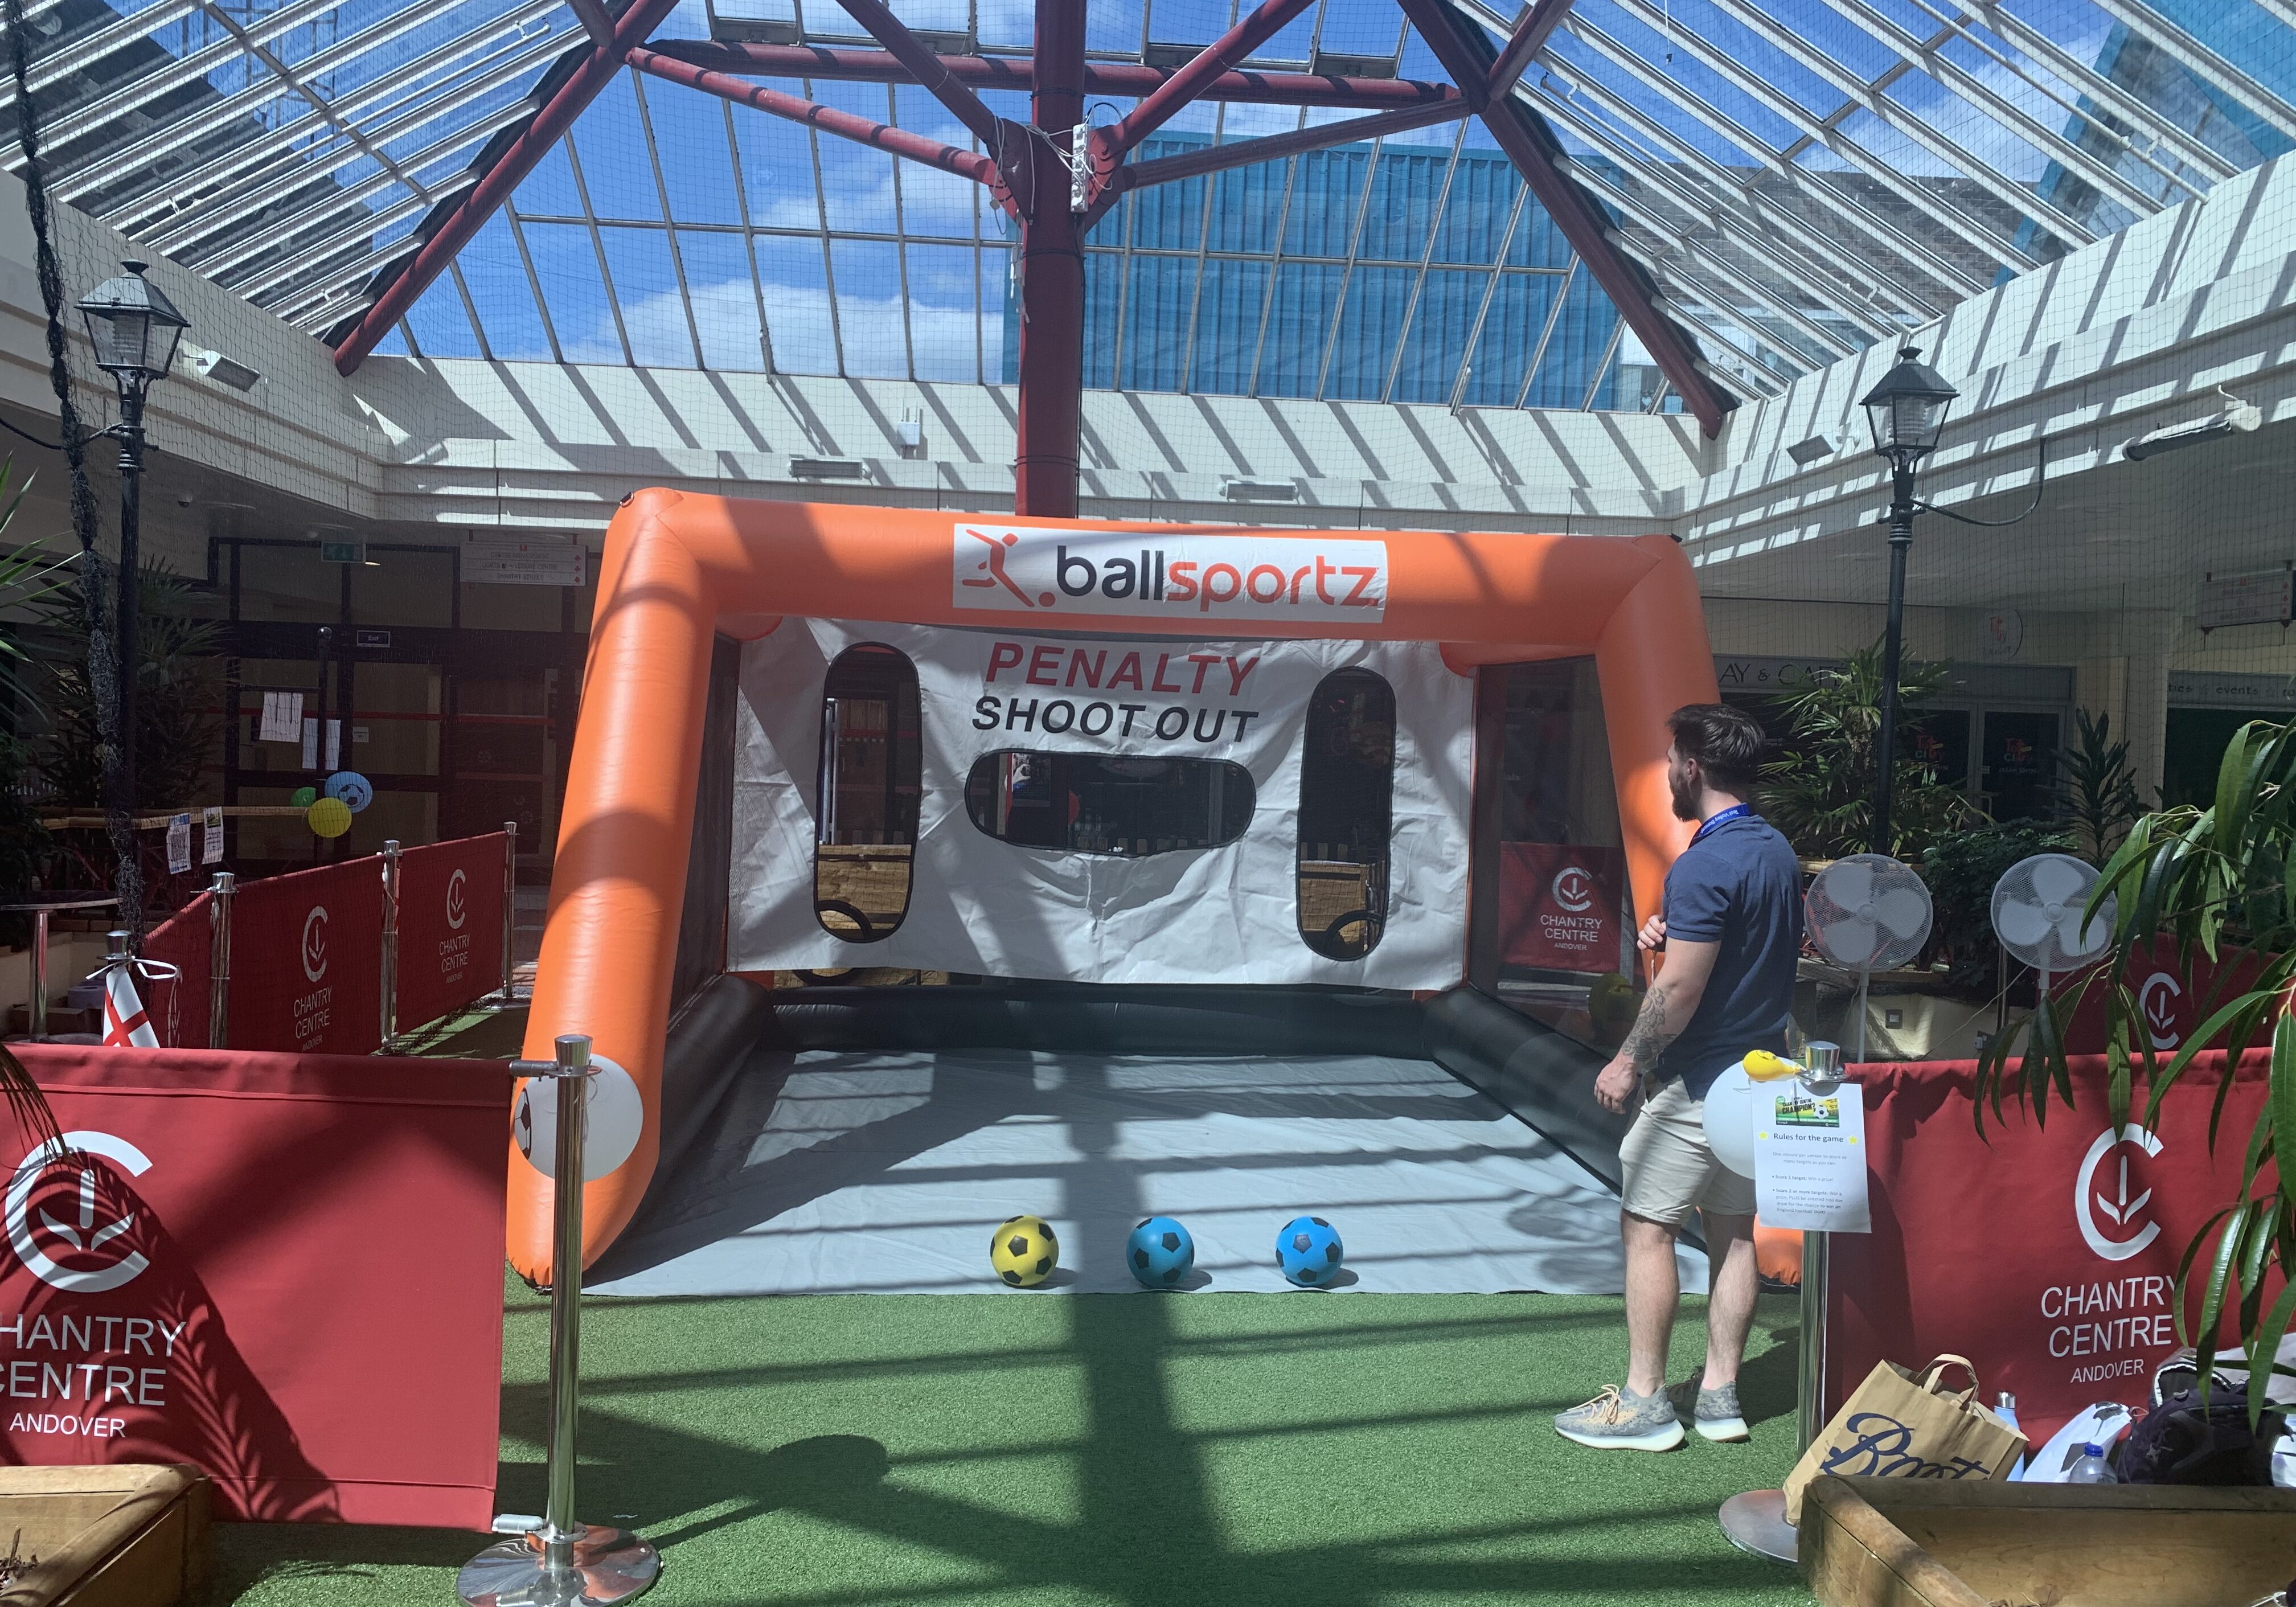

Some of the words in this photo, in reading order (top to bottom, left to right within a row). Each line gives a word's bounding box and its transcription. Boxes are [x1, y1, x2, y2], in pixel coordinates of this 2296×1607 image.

[1056, 544, 1380, 612] ballsportz
[986, 642, 1260, 696] PENALTY
[2216, 685, 2258, 695] events
[972, 696, 1146, 736] SHOOT
[1155, 706, 1259, 743] OUT
[1540, 915, 1602, 929] CHANTRY
[1545, 928, 1598, 942] CENTRE
[439, 933, 471, 956] CHANTRY
[1555, 942, 1588, 950] ANDOVER
[441, 952, 469, 973] CENTRE
[294, 985, 333, 1018] CHANTRY
[296, 1008, 330, 1039] CENTRE
[0, 1313, 187, 1357] HANTRY
[2049, 1314, 2172, 1358] CENTRE
[0, 1360, 166, 1406] ENTRE
[2070, 1359, 2145, 1383] ANDOVER
[9, 1412, 126, 1438] ANDOVER
